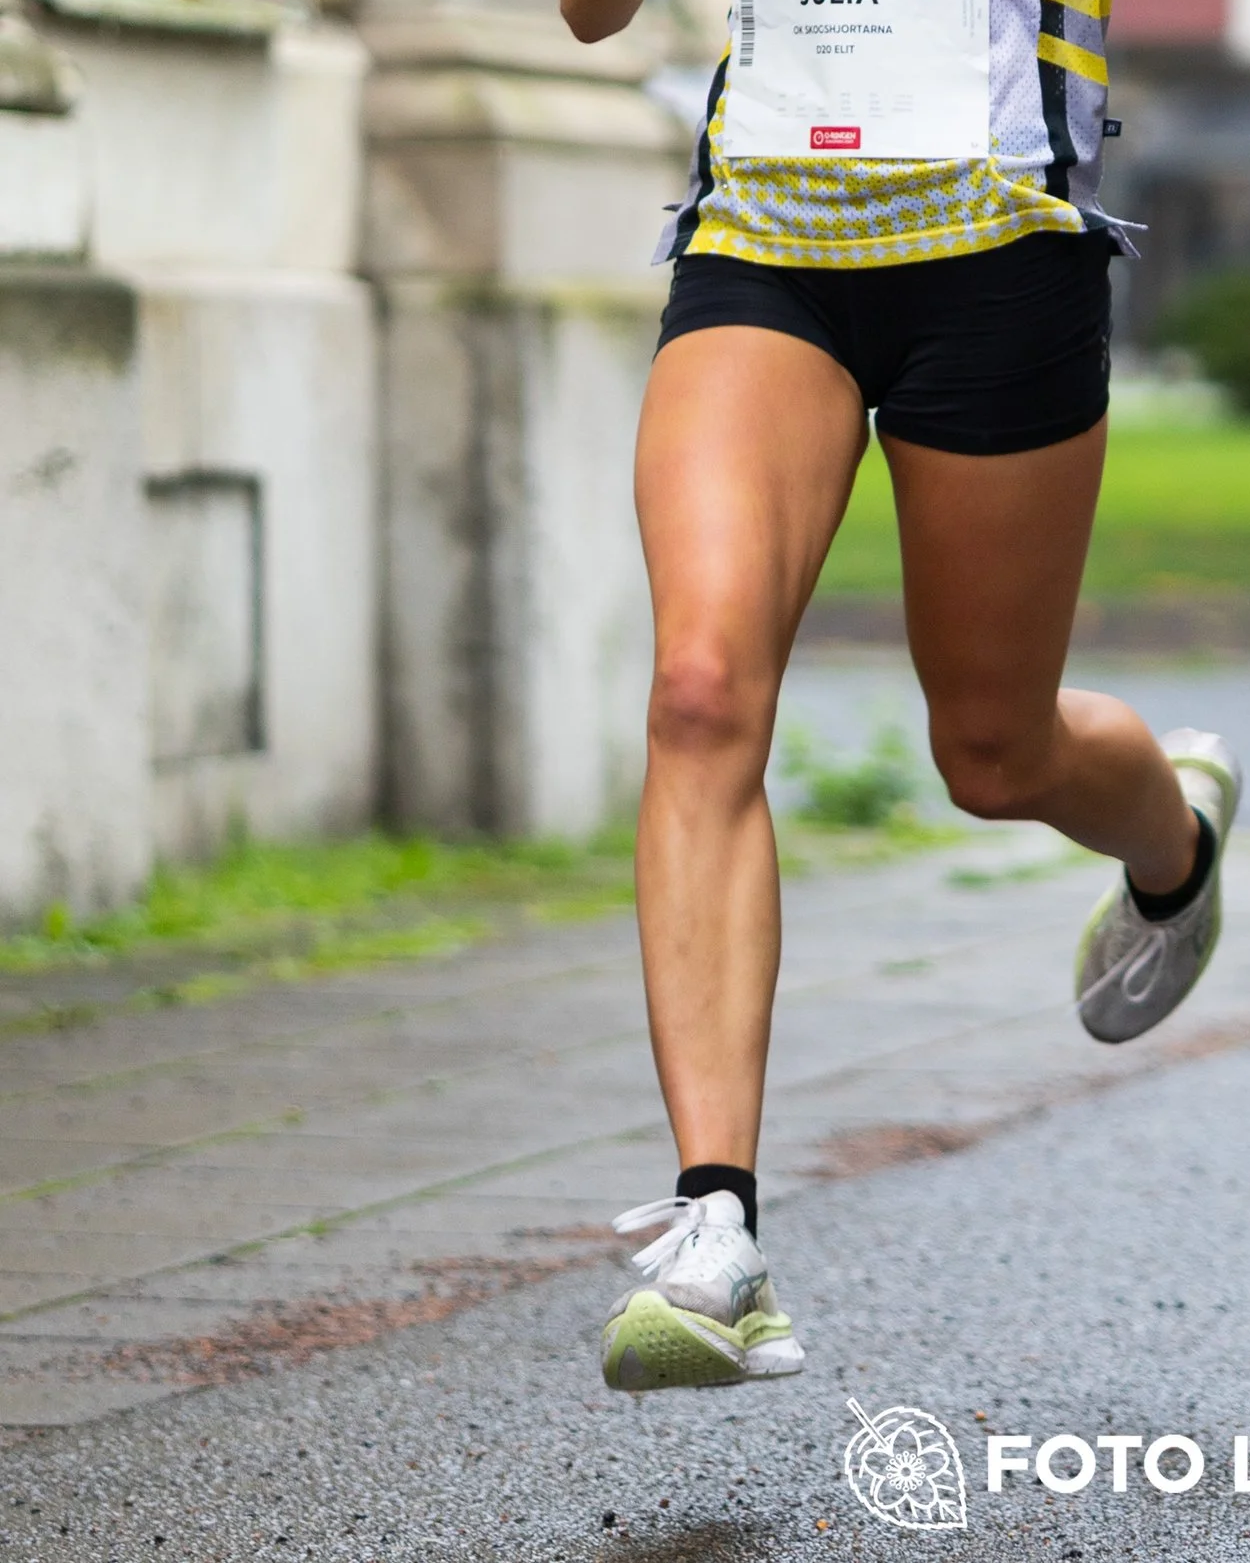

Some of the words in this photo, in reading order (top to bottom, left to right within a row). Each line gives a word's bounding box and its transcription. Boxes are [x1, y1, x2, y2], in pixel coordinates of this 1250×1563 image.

[793, 25, 803, 35] OK
[816, 44, 832, 54] D20
[834, 44, 855, 54] ELIT
